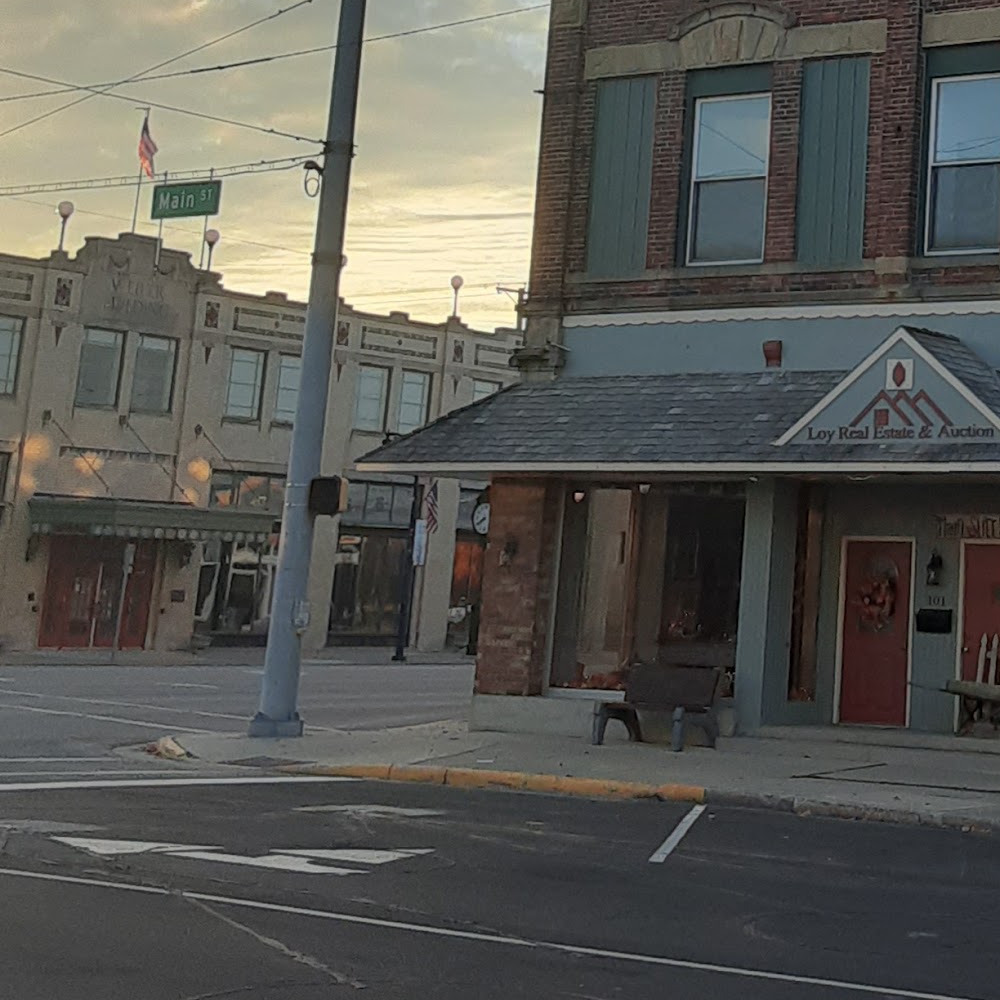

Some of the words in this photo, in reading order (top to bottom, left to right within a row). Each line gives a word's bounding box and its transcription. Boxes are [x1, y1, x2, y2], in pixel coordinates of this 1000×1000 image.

[159, 190, 195, 210] Main
[201, 188, 213, 201] ST
[808, 426, 835, 443] Loy
[839, 425, 869, 440] Real
[873, 424, 914, 440] Estate
[918, 425, 932, 439] &
[937, 424, 995, 438] Auction
[928, 595, 946, 607] 101
